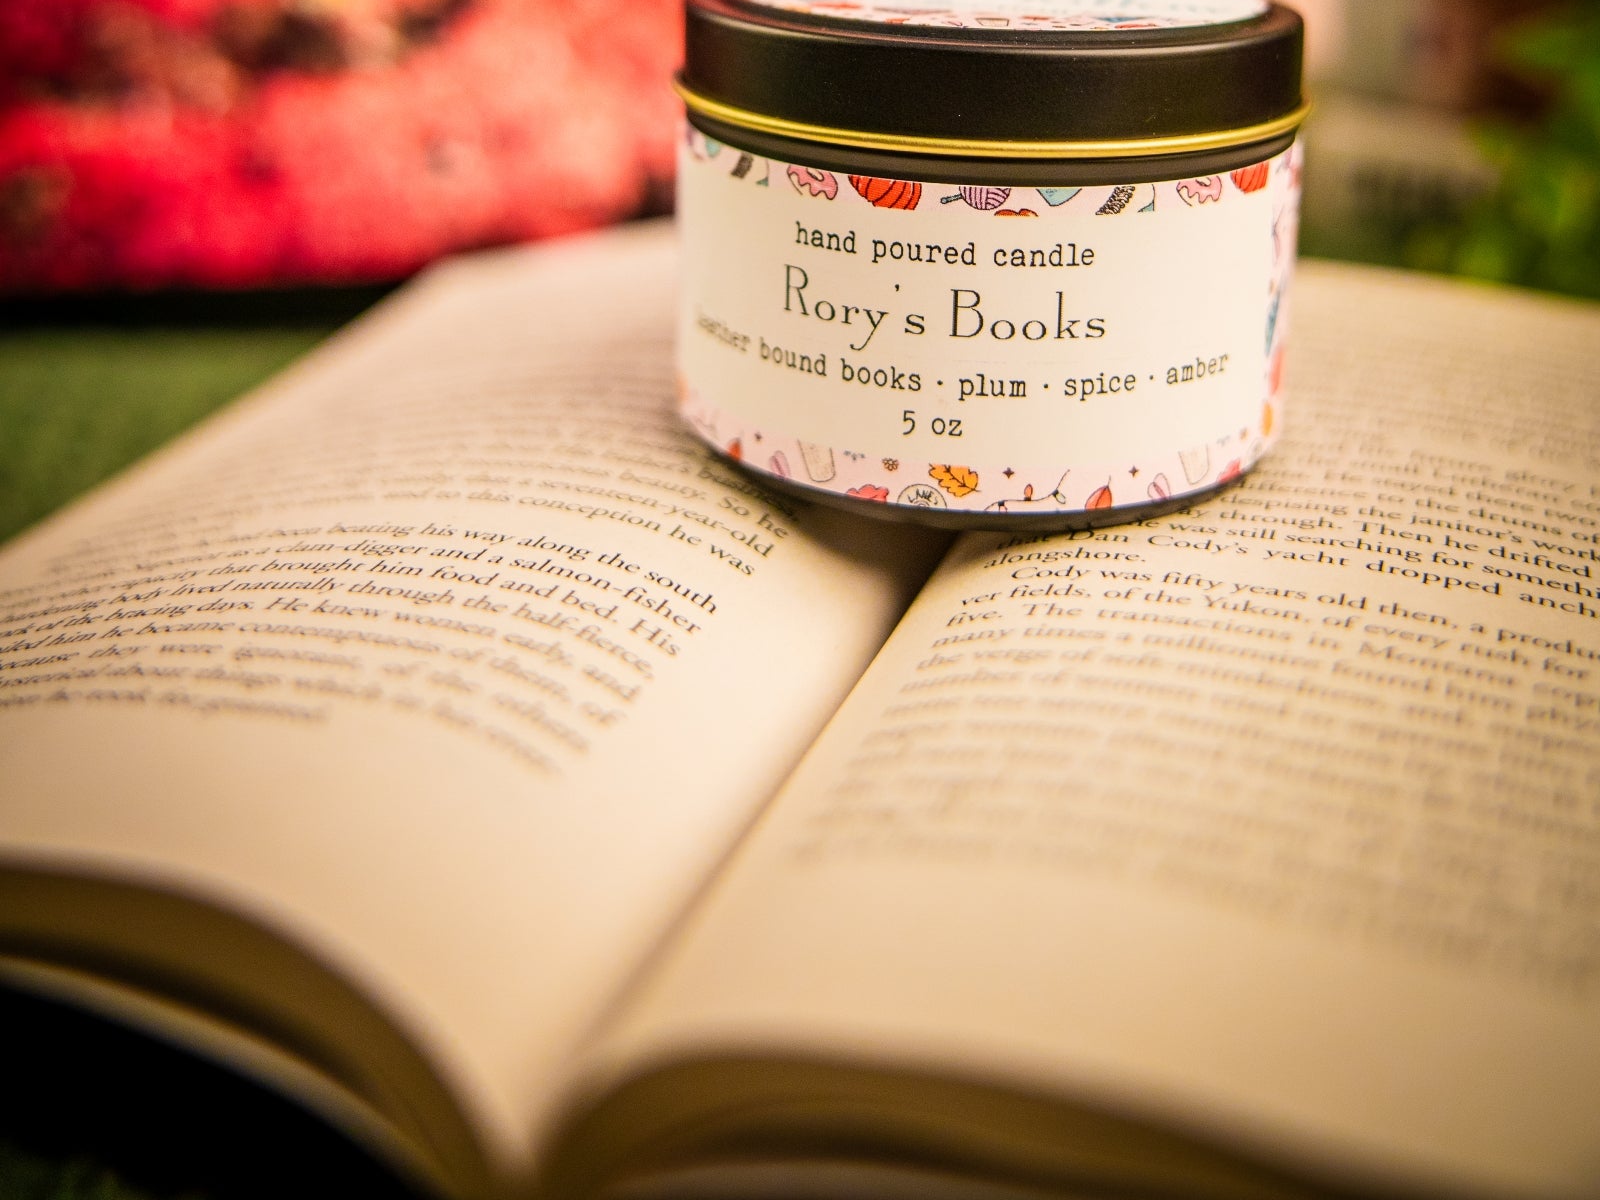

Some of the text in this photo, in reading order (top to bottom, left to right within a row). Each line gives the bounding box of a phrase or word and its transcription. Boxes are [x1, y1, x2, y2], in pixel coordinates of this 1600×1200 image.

[795, 222, 1096, 267] hand poured candle
[784, 264, 1107, 351] Rory's Books
[759, 336, 827, 377] bound
[841, 356, 923, 392] books
[959, 372, 1028, 402] plum
[1064, 371, 1137, 402] spice
[1166, 351, 1231, 388] amber
[902, 409, 964, 438] 5 oz
[518, 494, 662, 533] conception
[668, 524, 703, 546] he
[709, 543, 756, 576] was
[719, 496, 751, 517] So
[757, 513, 790, 539] he
[1168, 522, 1220, 535] was
[1226, 526, 1278, 541] still
[1284, 533, 1423, 563] searching
[1431, 550, 1475, 570] for
[1219, 508, 1344, 532] through.
[1352, 518, 1434, 545] Then
[1443, 534, 1480, 553] he
[1487, 544, 1593, 580] drifted
[1357, 504, 1403, 520] the
[1408, 512, 1523, 544] janitor's
[1530, 538, 1600, 564] work
[1414, 496, 1460, 514] the
[1467, 506, 1563, 537] drums
[274, 538, 429, 557] clam-digger
[429, 548, 489, 562] and
[487, 555, 505, 565] a
[508, 557, 703, 635] salmon-fisher
[419, 522, 458, 537] his
[463, 529, 515, 546] way
[516, 535, 594, 562] along
[597, 552, 642, 574] the
[643, 570, 718, 615] south
[983, 546, 1147, 569] alongshore.
[1065, 524, 1130, 544] Dan
[1147, 534, 1249, 555] Cody's
[1262, 549, 1351, 567] yacht
[1365, 559, 1502, 596] dropped
[169, 579, 236, 597] lived
[231, 576, 347, 596] naturally
[347, 580, 456, 606] through
[461, 595, 509, 613] the
[511, 603, 655, 680] half-fierce,
[196, 597, 255, 615] days.
[264, 597, 310, 612] He
[311, 599, 388, 618] knew
[394, 611, 498, 639] women
[260, 558, 367, 575] brought
[367, 558, 424, 577] him
[429, 564, 501, 587] food
[499, 579, 560, 600] and
[560, 589, 620, 625] bed.
[628, 617, 679, 657] His
[946, 609, 1003, 628] five.
[1022, 602, 1084, 618] The
[961, 589, 1003, 607] ver
[1008, 584, 1092, 599] fields,
[1102, 586, 1144, 601] of
[1143, 588, 1193, 606] the
[1202, 594, 1312, 625] Yukon,
[1321, 614, 1362, 629] of
[1363, 622, 1450, 650] every
[1010, 565, 1092, 581] Cody
[1100, 569, 1153, 582] was
[1161, 571, 1224, 591] fifty
[1229, 582, 1308, 601] years
[1316, 592, 1369, 611] old
[1377, 601, 1460, 630] then,
[1468, 622, 1487, 634] a
[45, 632, 98, 647] him
[99, 625, 134, 640] he
